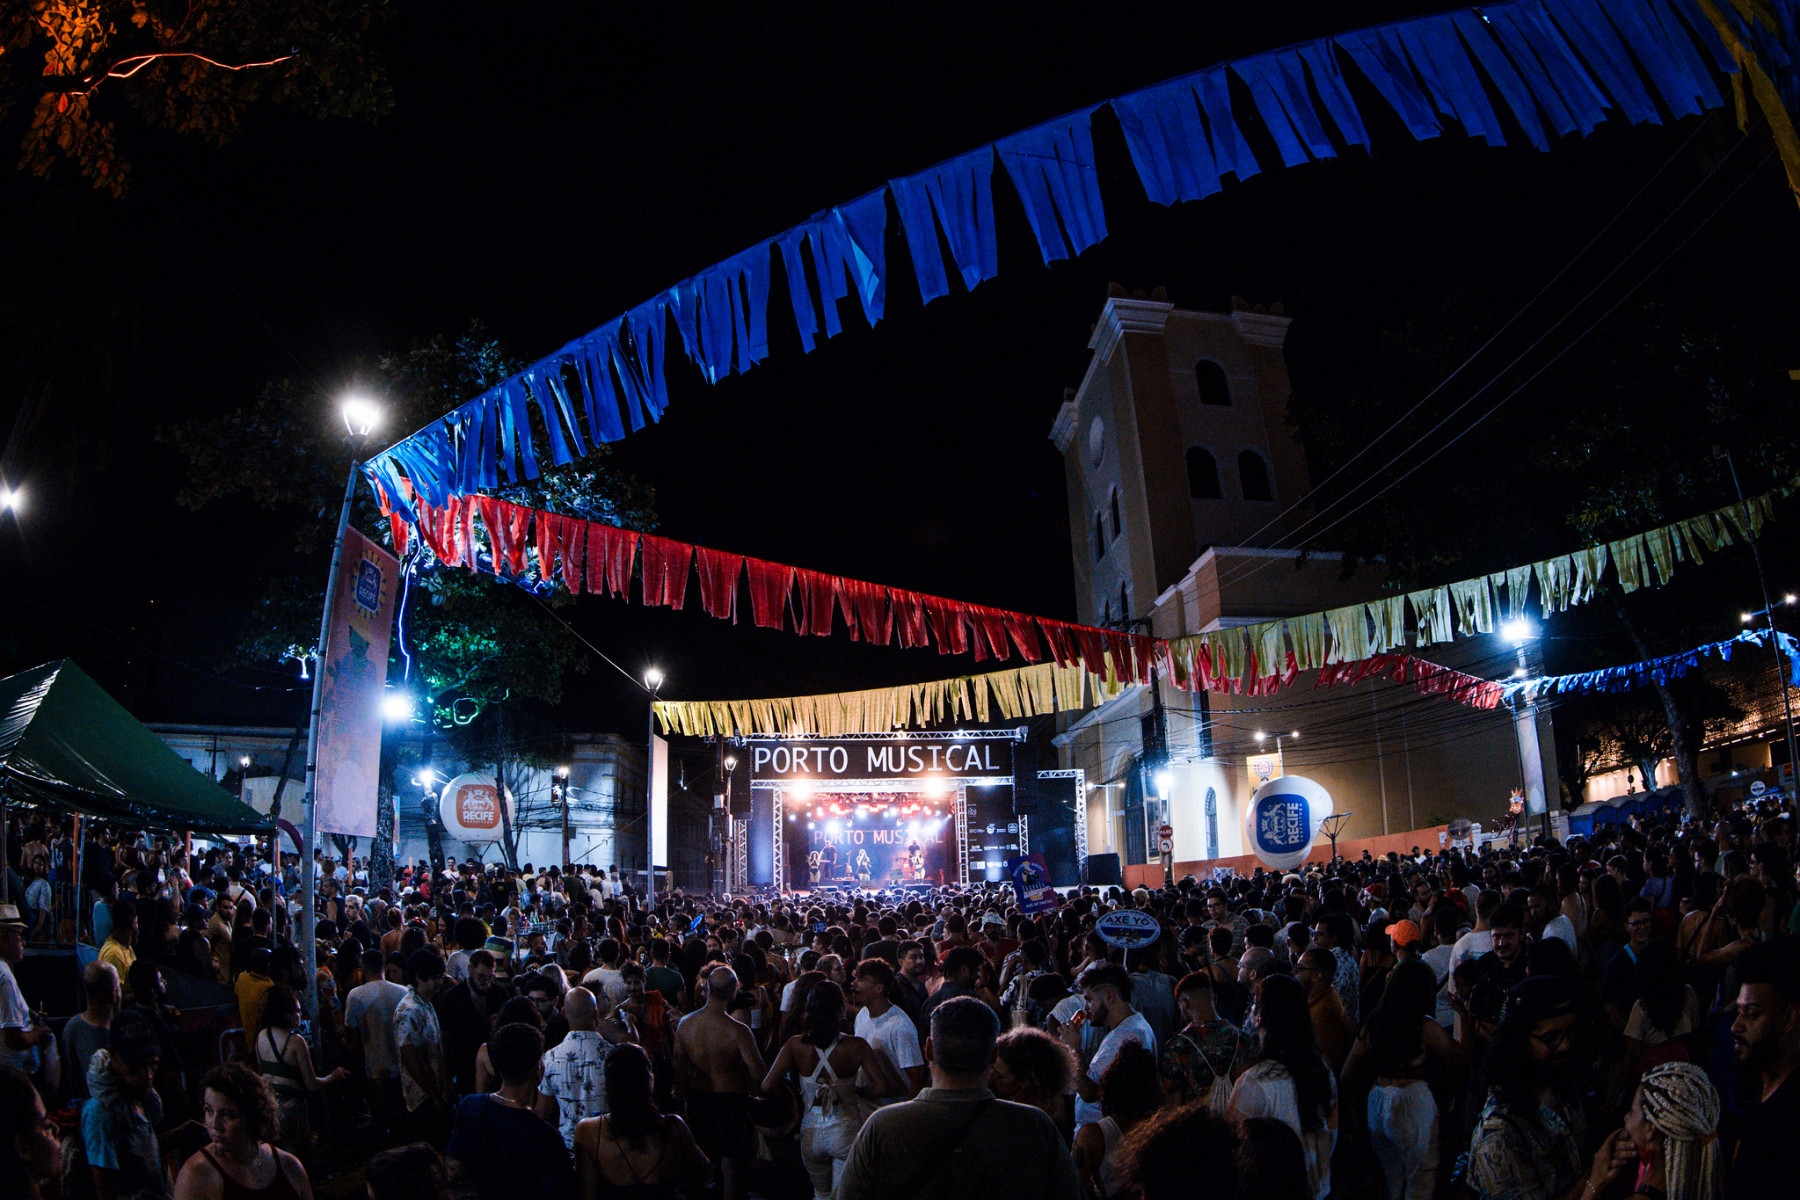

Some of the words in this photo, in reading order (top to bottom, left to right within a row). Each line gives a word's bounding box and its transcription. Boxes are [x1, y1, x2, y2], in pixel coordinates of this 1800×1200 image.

[754, 746, 848, 774] PORTO
[867, 745, 1000, 773] MUSICAL
[463, 810, 494, 822] RECIFE
[1287, 802, 1300, 845] RECIFE
[814, 829, 864, 845] PORTO
